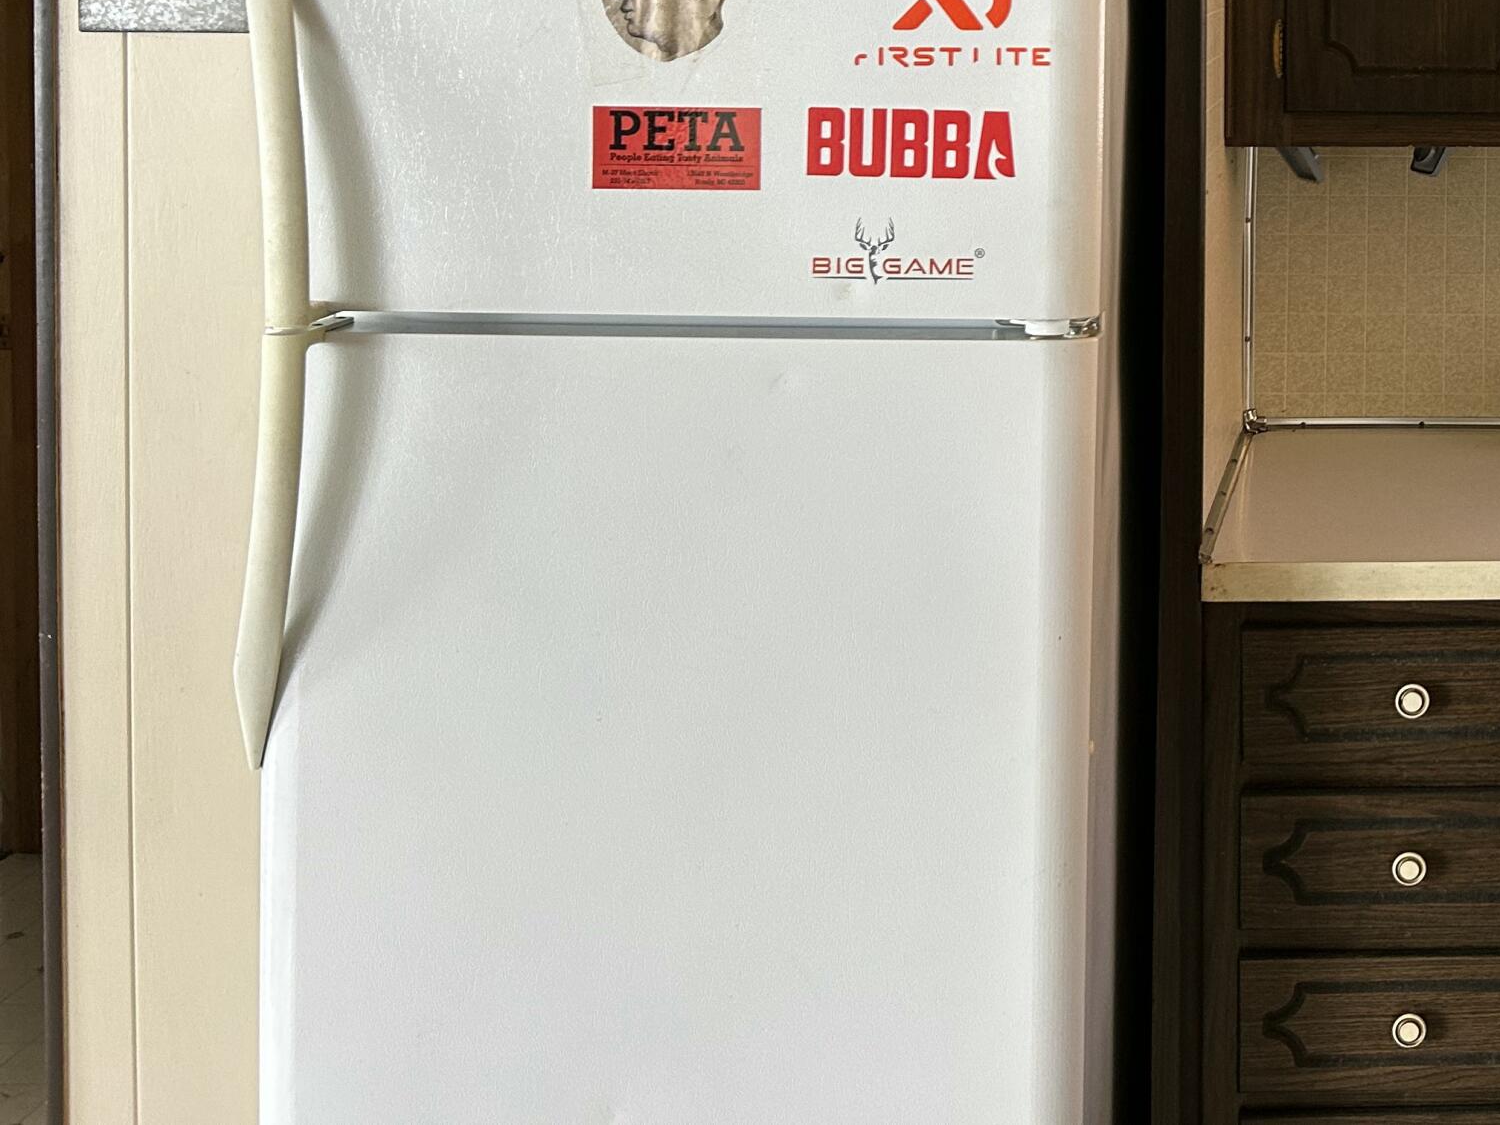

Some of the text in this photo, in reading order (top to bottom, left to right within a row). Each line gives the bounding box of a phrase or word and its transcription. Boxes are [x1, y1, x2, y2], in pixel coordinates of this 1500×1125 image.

[609, 109, 745, 152] PETA
[806, 106, 1016, 179] BUBBA
[610, 152, 642, 163] People
[644, 153, 675, 164] Eating
[677, 153, 702, 164] Tasty
[812, 257, 974, 275] BIG GAME
